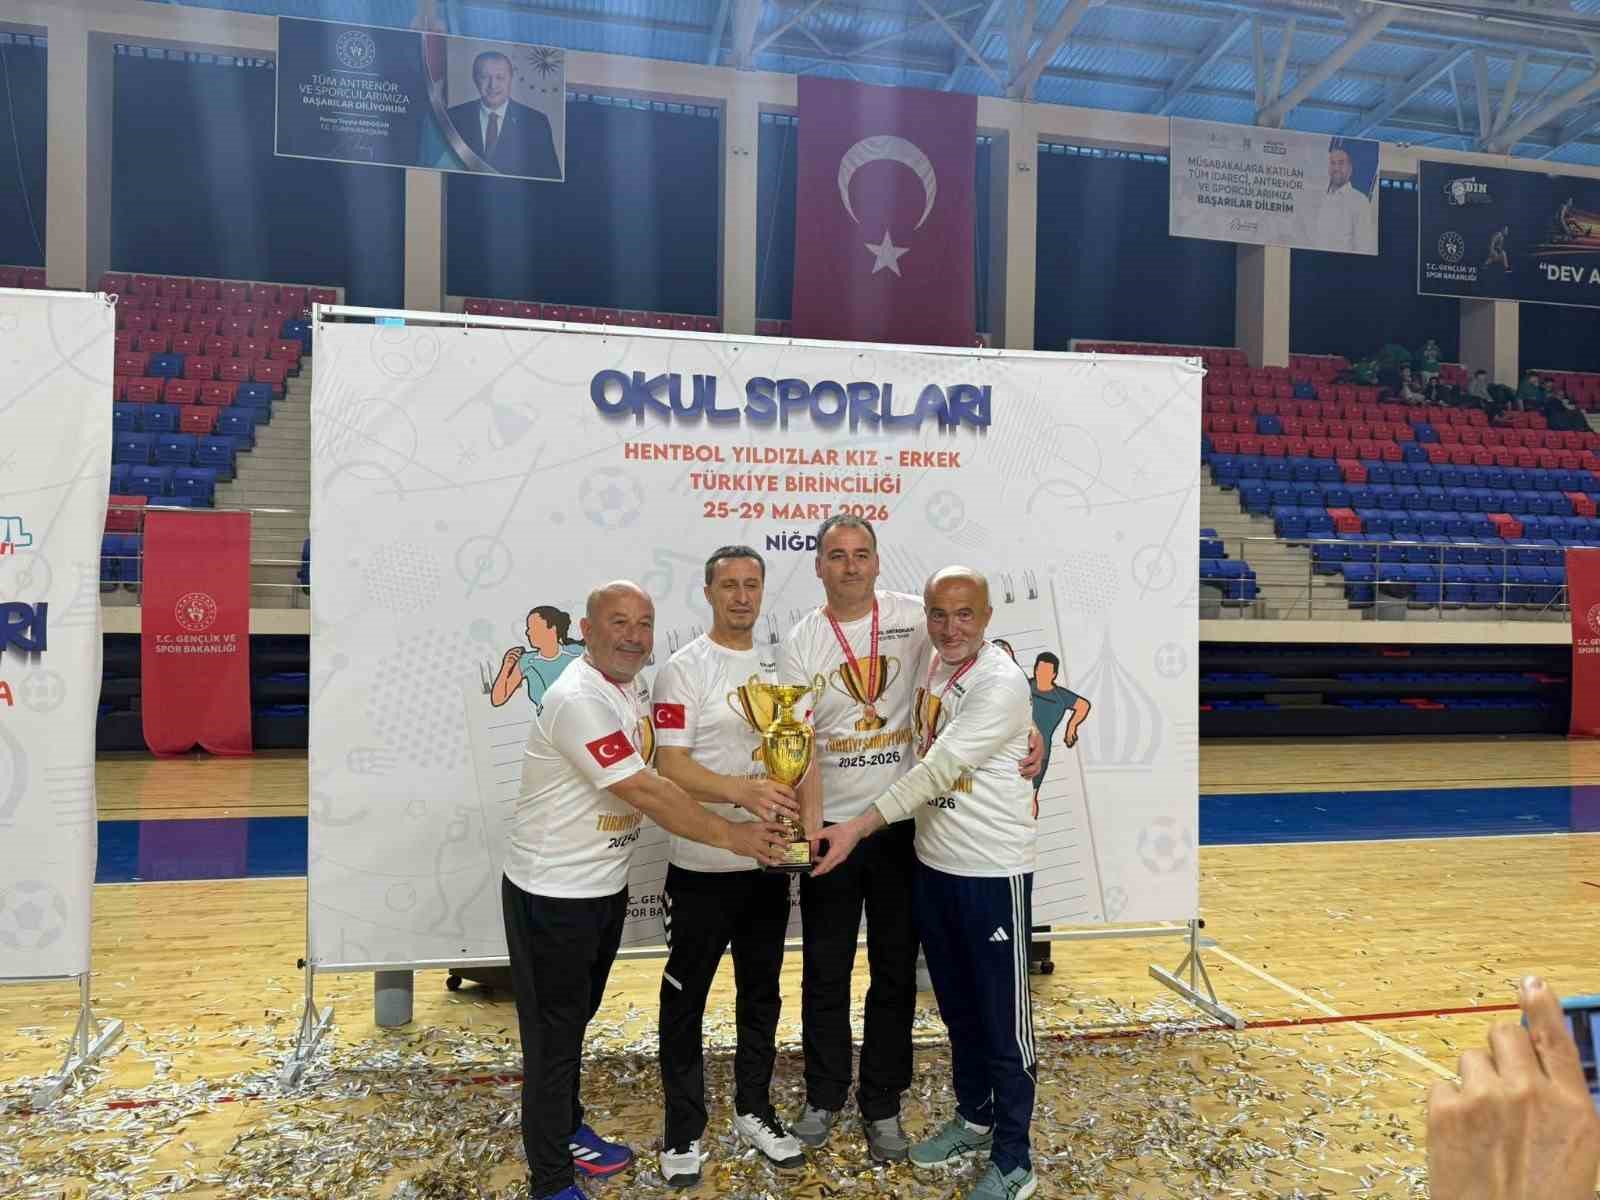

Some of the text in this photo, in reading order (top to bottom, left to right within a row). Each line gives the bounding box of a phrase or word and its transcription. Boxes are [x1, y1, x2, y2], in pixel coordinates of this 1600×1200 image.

[1198, 194, 1294, 213] BAŞARILAR DİLERİM
[591, 369, 992, 430] OKUL SPORLARI
[624, 442, 725, 463] HENTBOL
[732, 446, 838, 465] YILDIZLAR
[846, 450, 878, 466] KIZ
[900, 451, 961, 468] ERKEK
[690, 470, 902, 494] TÜRKİYE BİRİNCİLİĞİ
[703, 501, 765, 519] 25-29
[772, 503, 832, 520] MART
[766, 531, 817, 551] NİĞD
[176, 633, 220, 645] GENÇLİK
[223, 634, 237, 642] VE
[155, 645, 182, 653] SPOR
[838, 751, 900, 768] 2025-2026
